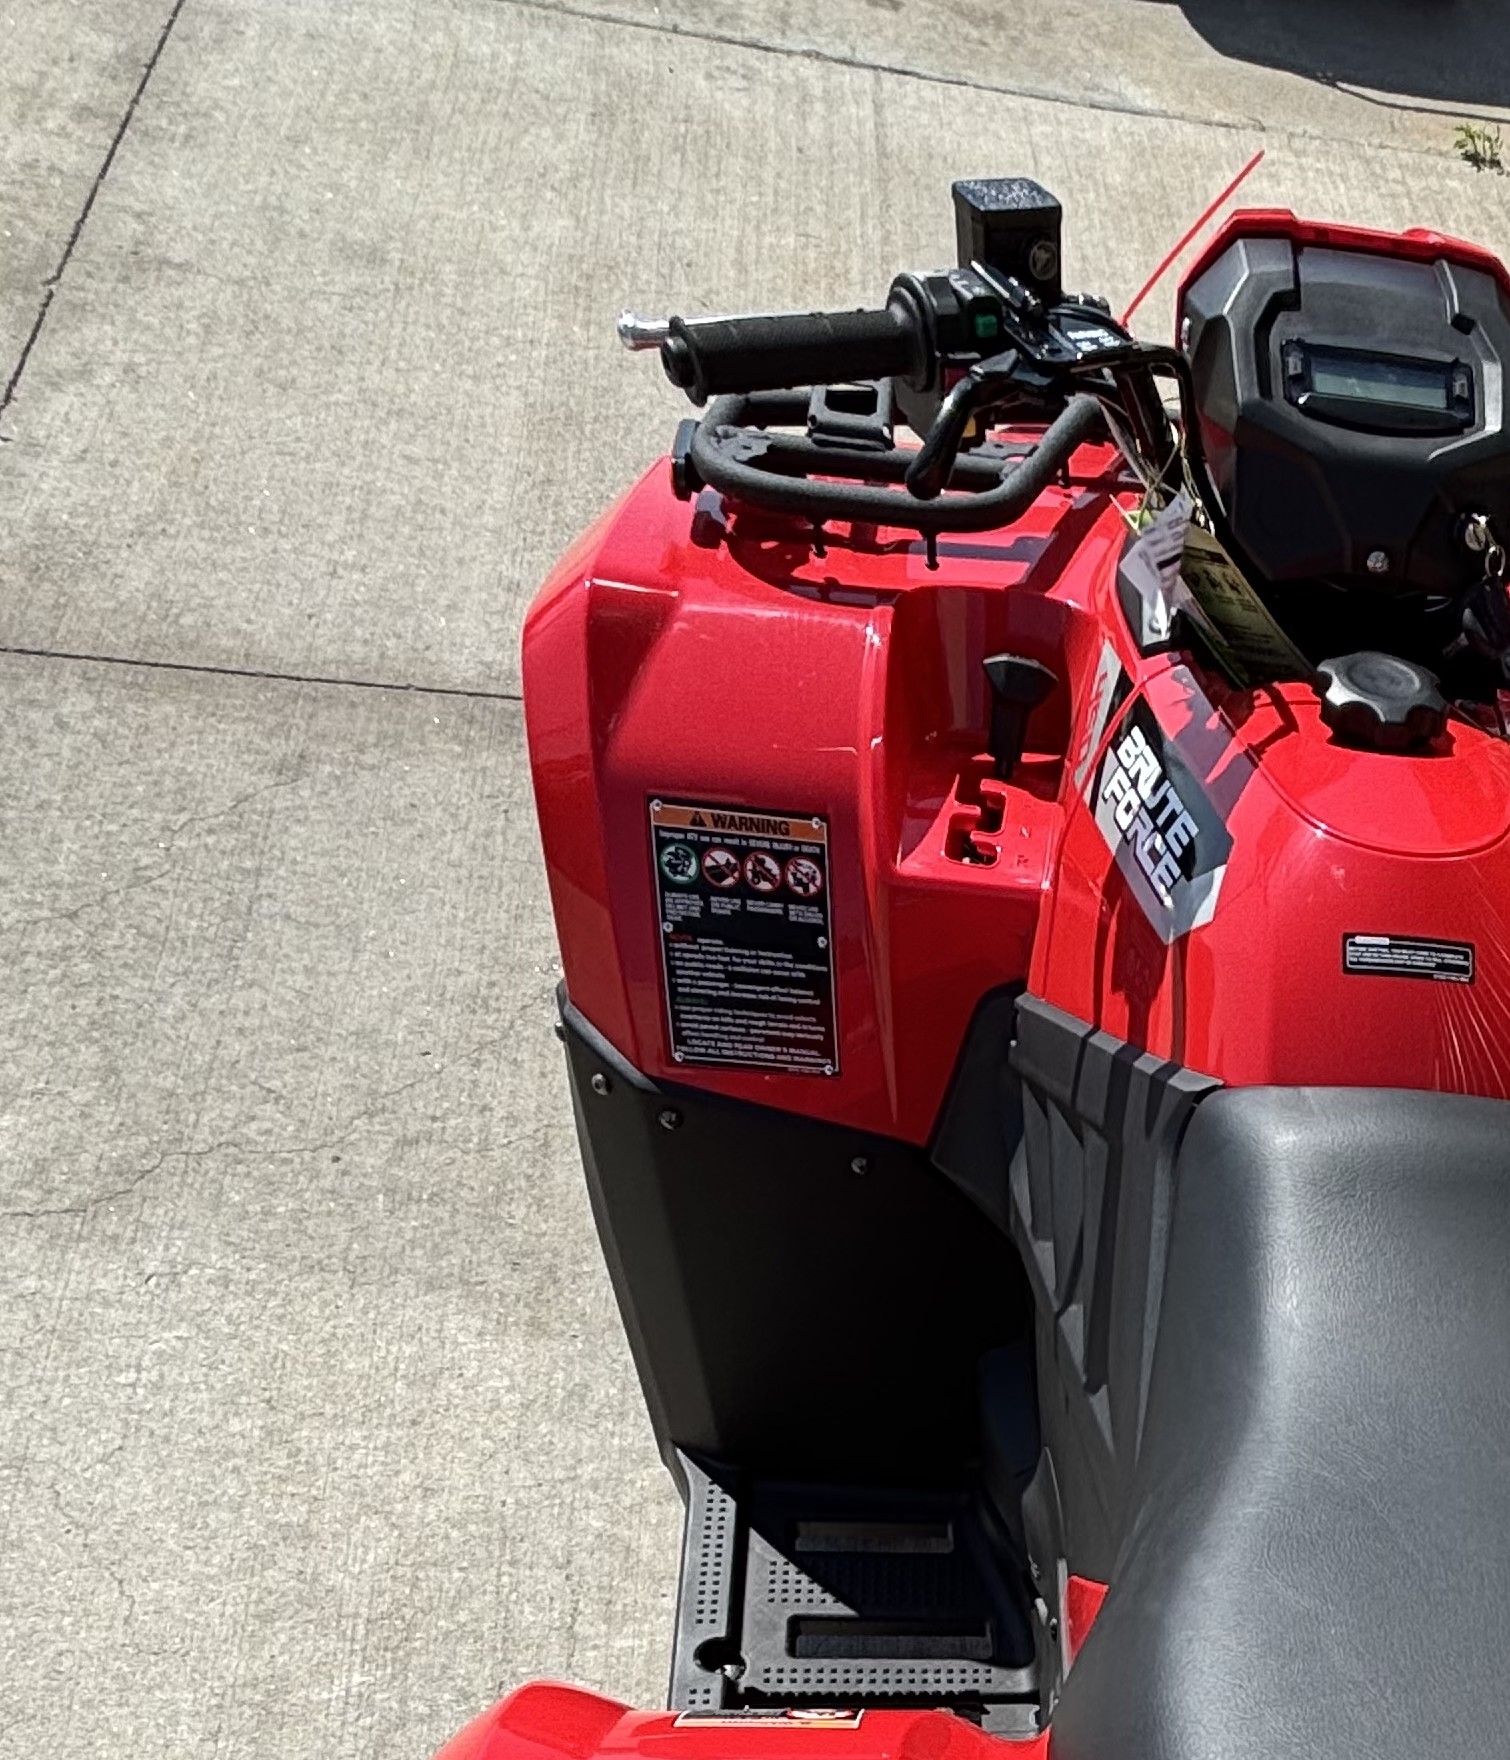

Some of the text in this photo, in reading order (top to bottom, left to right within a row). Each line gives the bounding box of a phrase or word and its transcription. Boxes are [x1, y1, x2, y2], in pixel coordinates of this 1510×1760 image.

[711, 813, 790, 836] WARNING
[1102, 766, 1182, 906] FORCE
[1117, 725, 1199, 858] BRUTE
